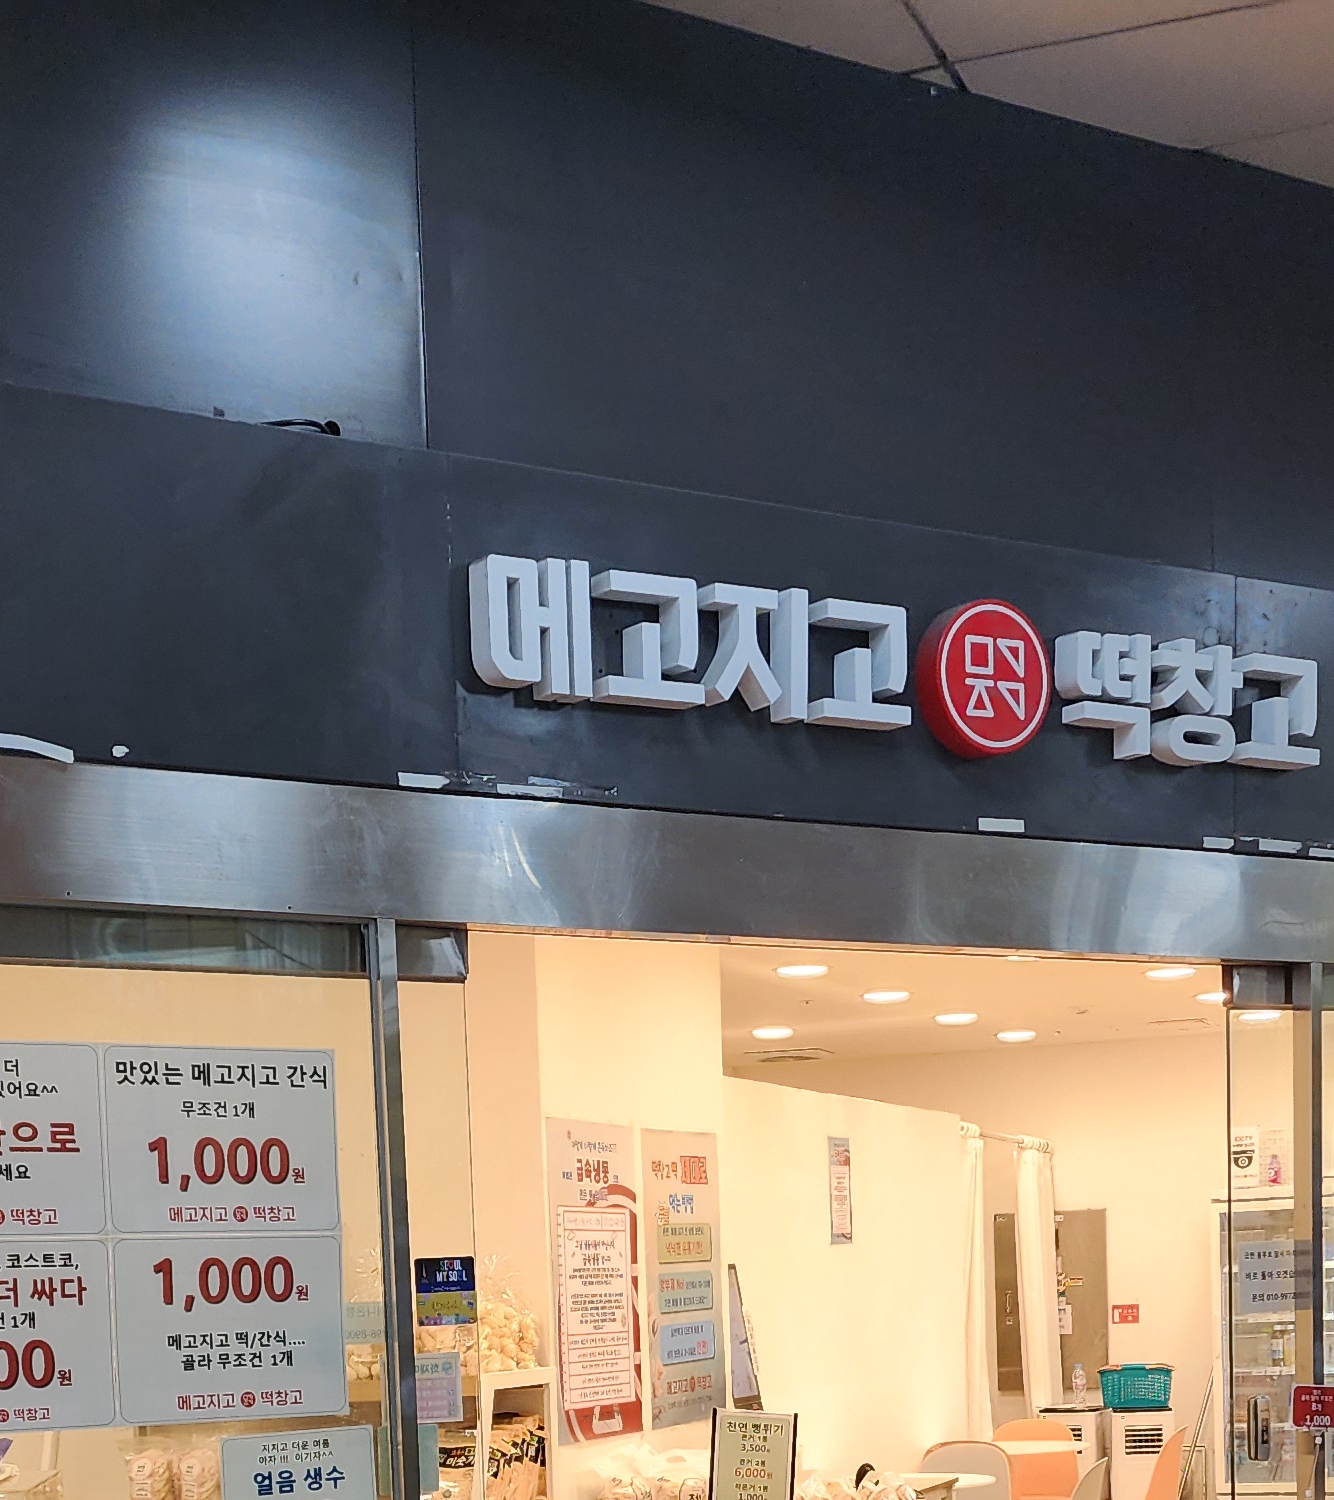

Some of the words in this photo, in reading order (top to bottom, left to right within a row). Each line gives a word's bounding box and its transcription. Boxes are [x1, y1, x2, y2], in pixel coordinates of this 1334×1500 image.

[469, 553, 912, 730] 메고지고
[1055, 630, 1320, 771] 떡창고
[4, 1059, 19, 1077] 더
[115, 1060, 183, 1085] 맛있는
[191, 1063, 280, 1088] 메고지고
[286, 1065, 327, 1089] 간식
[181, 1101, 228, 1118] 무조건
[233, 1102, 255, 1119] 1개
[11, 1209, 58, 1225] 떡창고
[169, 1206, 228, 1223] 메고지고
[253, 1206, 296, 1222] 떡창고
[6, 1253, 79, 1270] 코스트코,
[440, 1260, 462, 1270] SEOUL
[436, 1271, 447, 1282] MY
[449, 1270, 467, 1281] SOUL
[30, 1276, 87, 1306] 싸다
[11, 1312, 36, 1329] 1개
[168, 1333, 230, 1351] 메고지고
[181, 1353, 212, 1371] 골라
[217, 1351, 263, 1370] 무조건
[271, 1350, 293, 1366] 1개
[177, 1394, 235, 1411] 메고지고
[261, 1390, 303, 1406] 떡창고
[14, 1408, 51, 1422] 떡창고
[292, 1441, 310, 1451] 더운
[259, 1456, 277, 1466] 아자
[254, 1471, 296, 1496] 얼음
[304, 1466, 346, 1491] 생수
